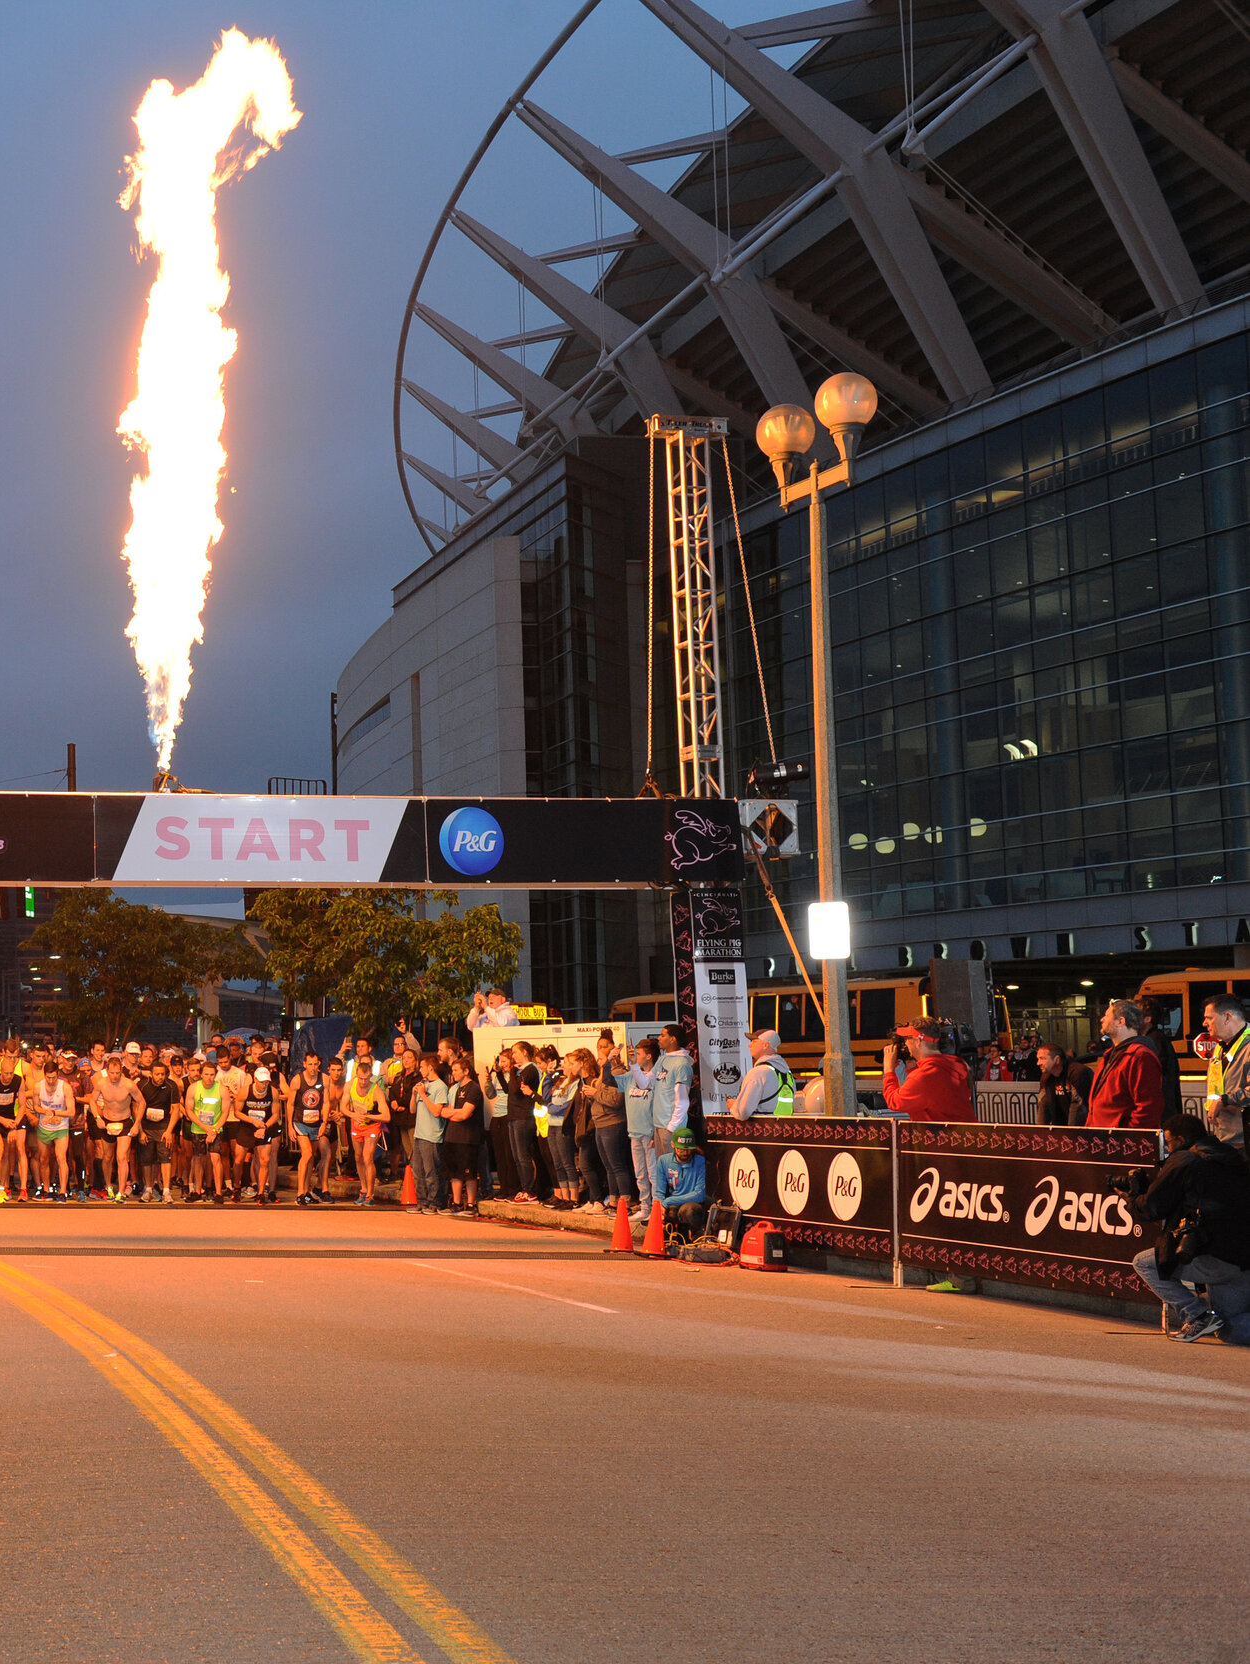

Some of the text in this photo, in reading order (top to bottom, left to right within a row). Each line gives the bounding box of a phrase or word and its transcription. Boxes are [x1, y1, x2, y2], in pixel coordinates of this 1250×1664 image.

[154, 816, 370, 862] START
[453, 830, 497, 853] P&G
[697, 939, 742, 947] FLYING PIG
[697, 948, 742, 956] MARATHON
[711, 972, 734, 980] Burke
[533, 1008, 545, 1017] BUS
[709, 1039, 740, 1048] CityDash
[1197, 1041, 1217, 1051] STOP
[736, 1169, 756, 1189] P&G
[784, 1172, 805, 1193] P&G
[834, 1175, 858, 1197] P&G
